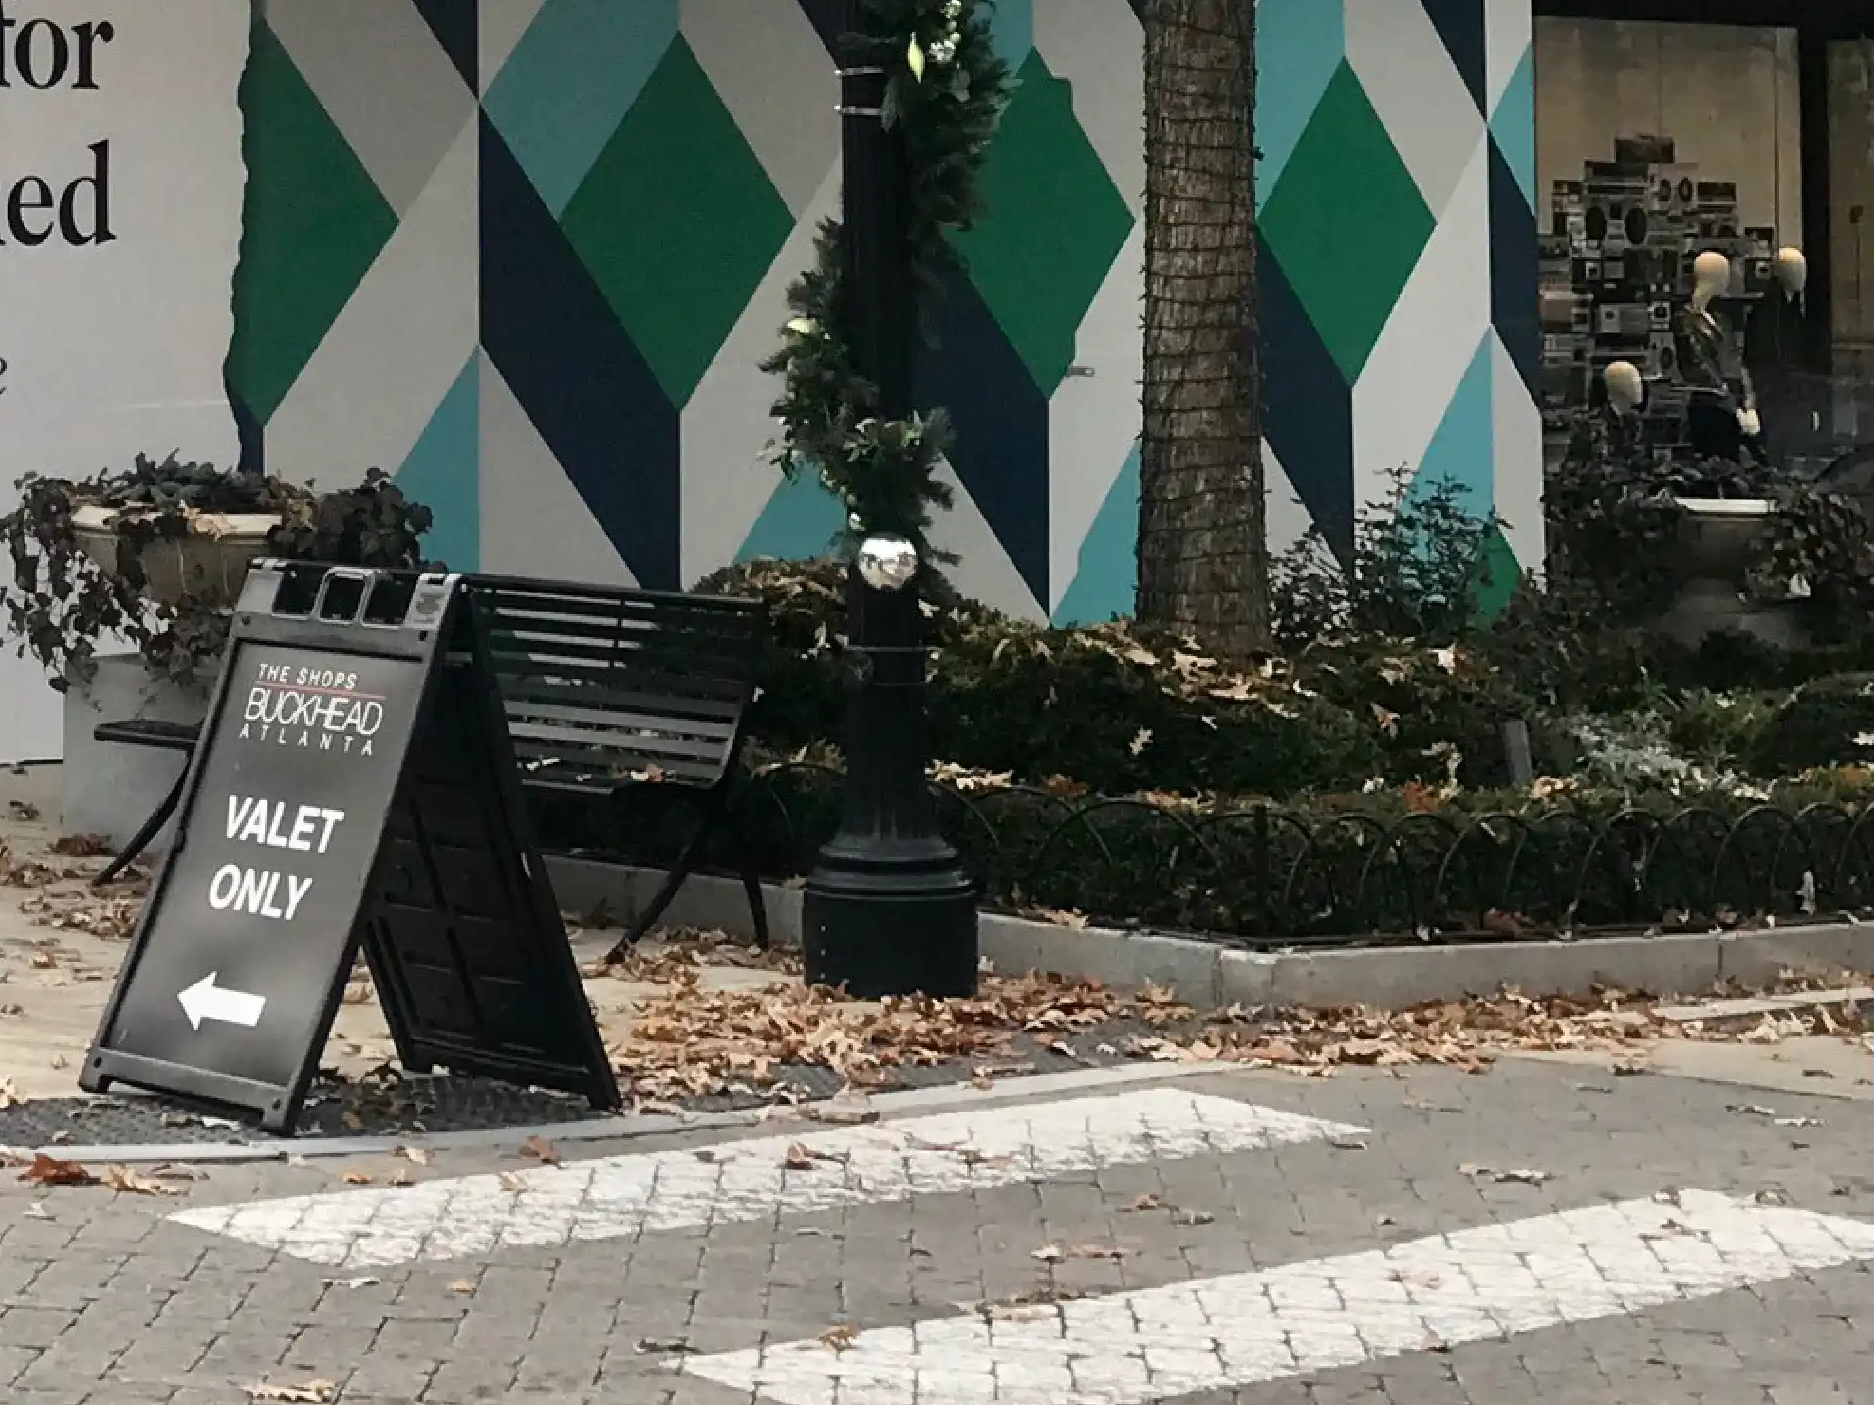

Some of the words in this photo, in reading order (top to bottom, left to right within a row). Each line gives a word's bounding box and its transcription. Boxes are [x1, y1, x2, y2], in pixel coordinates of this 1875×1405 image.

[258, 662, 292, 683] THE
[297, 667, 358, 691] SHOPS
[245, 687, 383, 736] BUCKHEAD
[238, 723, 373, 756] ATLANTA
[226, 794, 345, 854] VALET
[209, 864, 313, 921] ONLY
